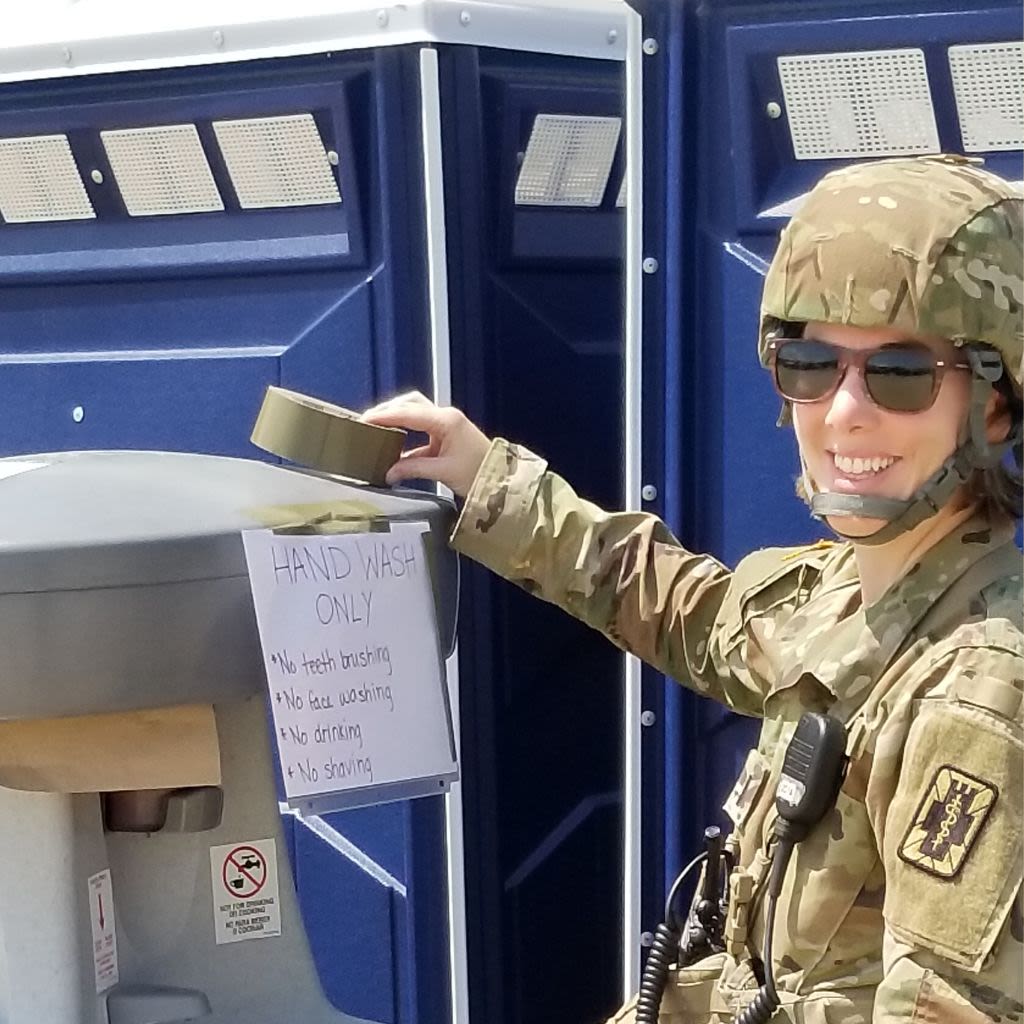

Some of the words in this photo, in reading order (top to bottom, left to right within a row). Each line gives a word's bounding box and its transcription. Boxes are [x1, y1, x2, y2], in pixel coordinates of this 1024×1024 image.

[272, 546, 351, 584] HAND
[356, 542, 417, 580] WASH
[316, 591, 373, 626] ONLY
[276, 650, 297, 675] No
[302, 649, 336, 676] teeth
[340, 645, 392, 676] brushing
[284, 688, 303, 710] No
[309, 690, 334, 712] face
[339, 683, 394, 712] washing
[292, 727, 308, 746] No
[315, 723, 363, 748] drinking
[298, 762, 318, 783] No
[324, 756, 373, 782] shaving
